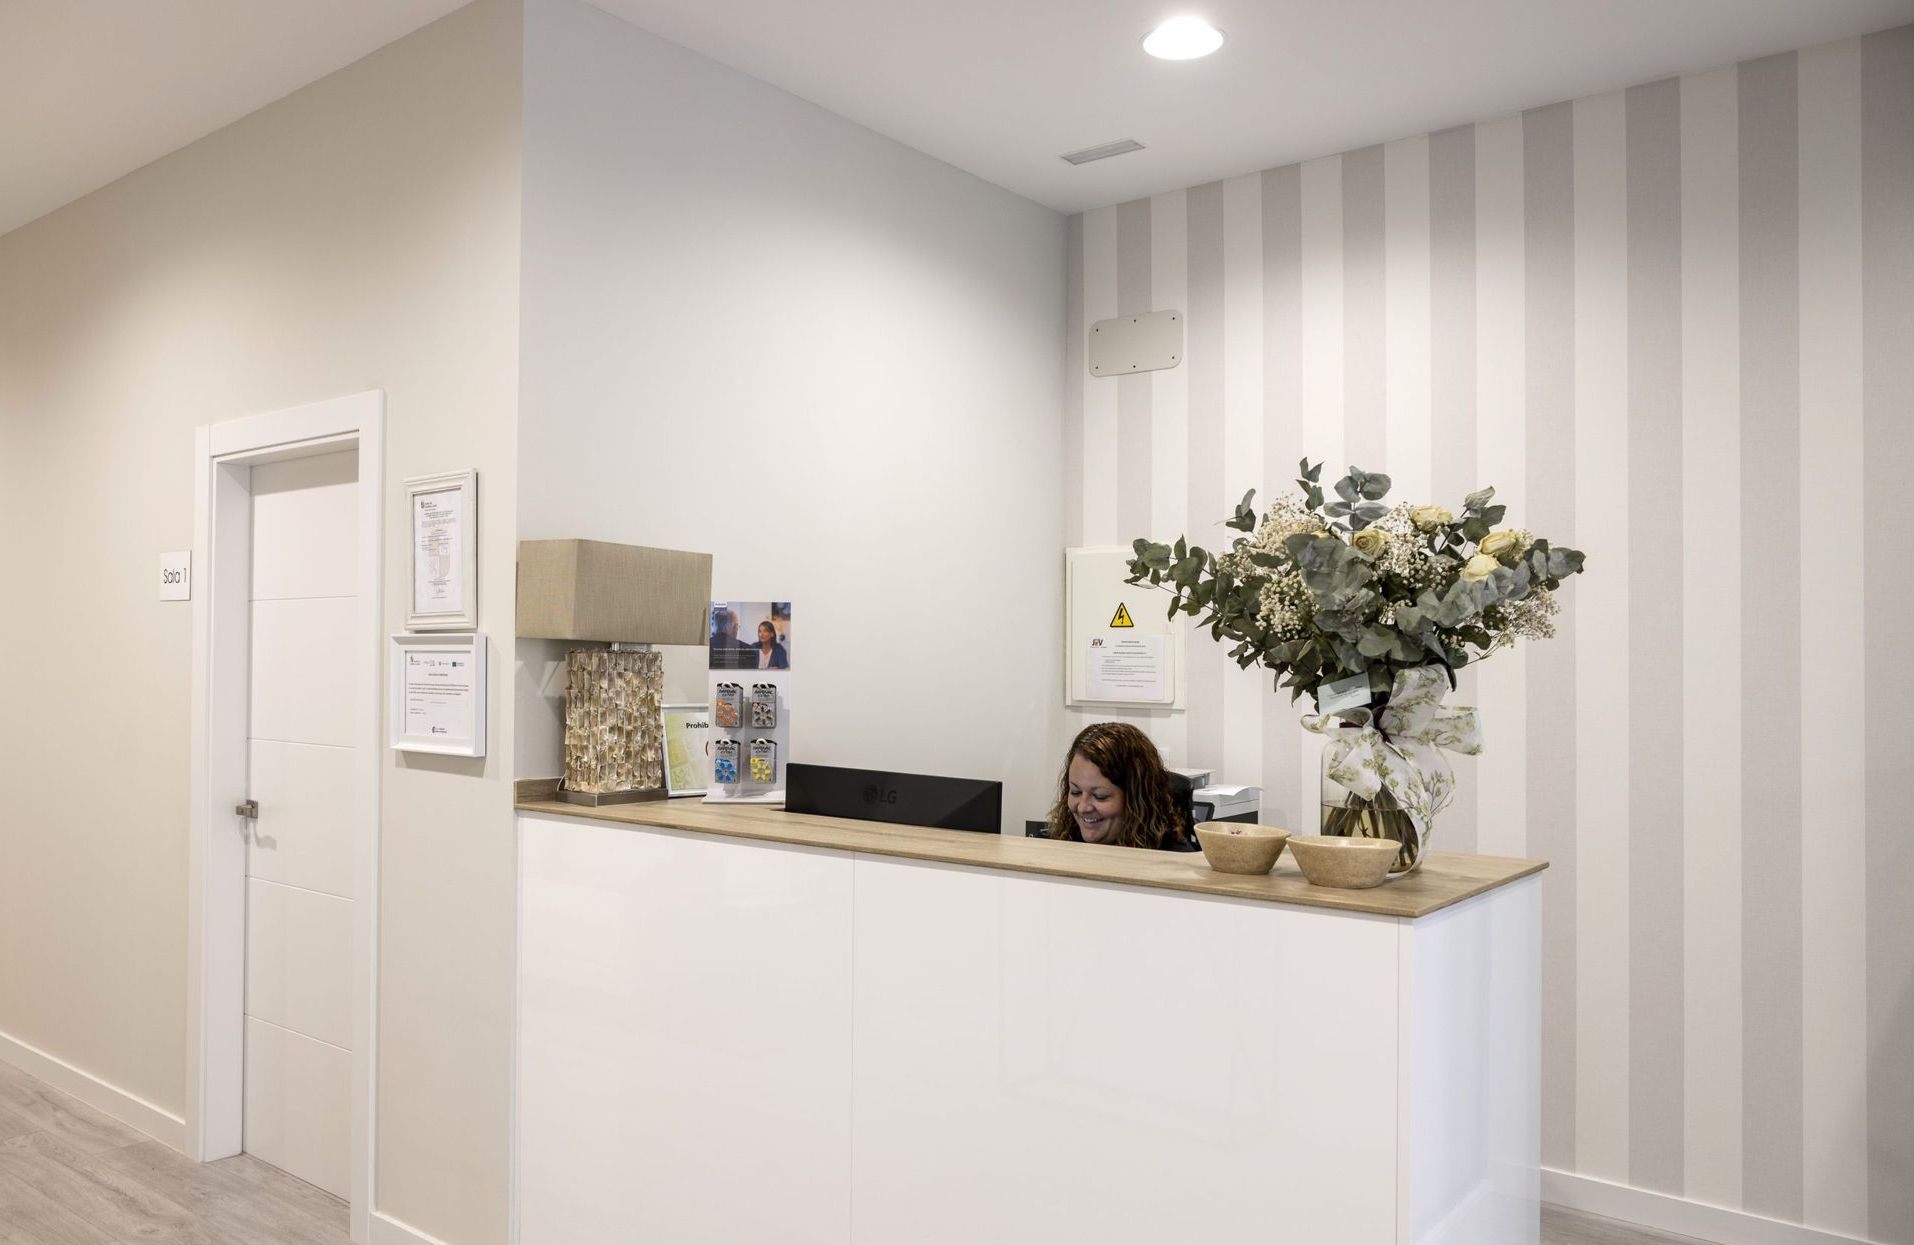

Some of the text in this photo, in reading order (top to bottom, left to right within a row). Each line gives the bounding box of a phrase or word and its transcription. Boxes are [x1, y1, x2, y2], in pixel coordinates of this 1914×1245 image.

[163, 567, 187, 584] Sala 1
[880, 790, 897, 804] LG
